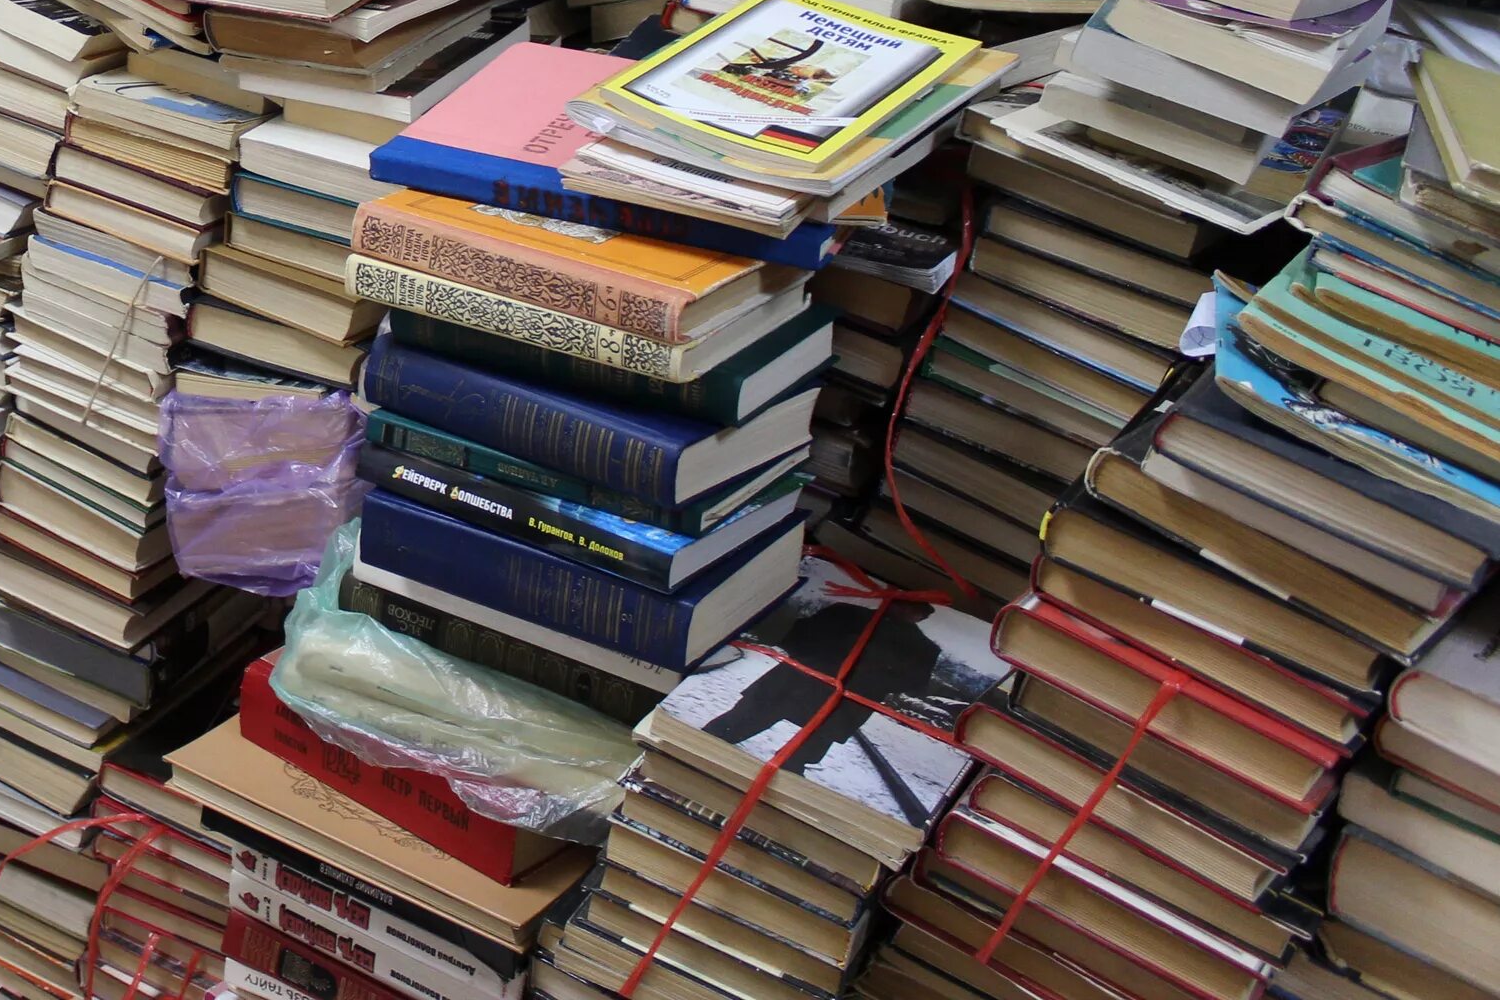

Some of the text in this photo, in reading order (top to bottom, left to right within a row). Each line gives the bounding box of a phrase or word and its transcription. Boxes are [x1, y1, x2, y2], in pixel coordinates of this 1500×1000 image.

[799, 9, 904, 51] Немецкий
[819, 2, 861, 22] ЧТЕНИЯ
[863, 14, 895, 31] ИЛЬИ
[805, 25, 873, 53] детям
[403, 228, 416, 263] ТЫСЯЧА
[420, 239, 431, 262] НОЧЬ
[400, 274, 409, 307] ТЫСЯЧА
[391, 464, 514, 521] ФЕЙЕРВЕРК ВОЛШЕБСТВА
[528, 517, 537, 529] В.
[538, 520, 576, 545] Гурангов,
[588, 538, 625, 562] Долохов
[386, 602, 435, 633] ЛЕСКОВ
[381, 769, 470, 832] ПЕТР ПЕРВЫЙ
[386, 924, 476, 976] Дмитрий Волкогонов
[244, 975, 287, 996] ТАЙГУ
